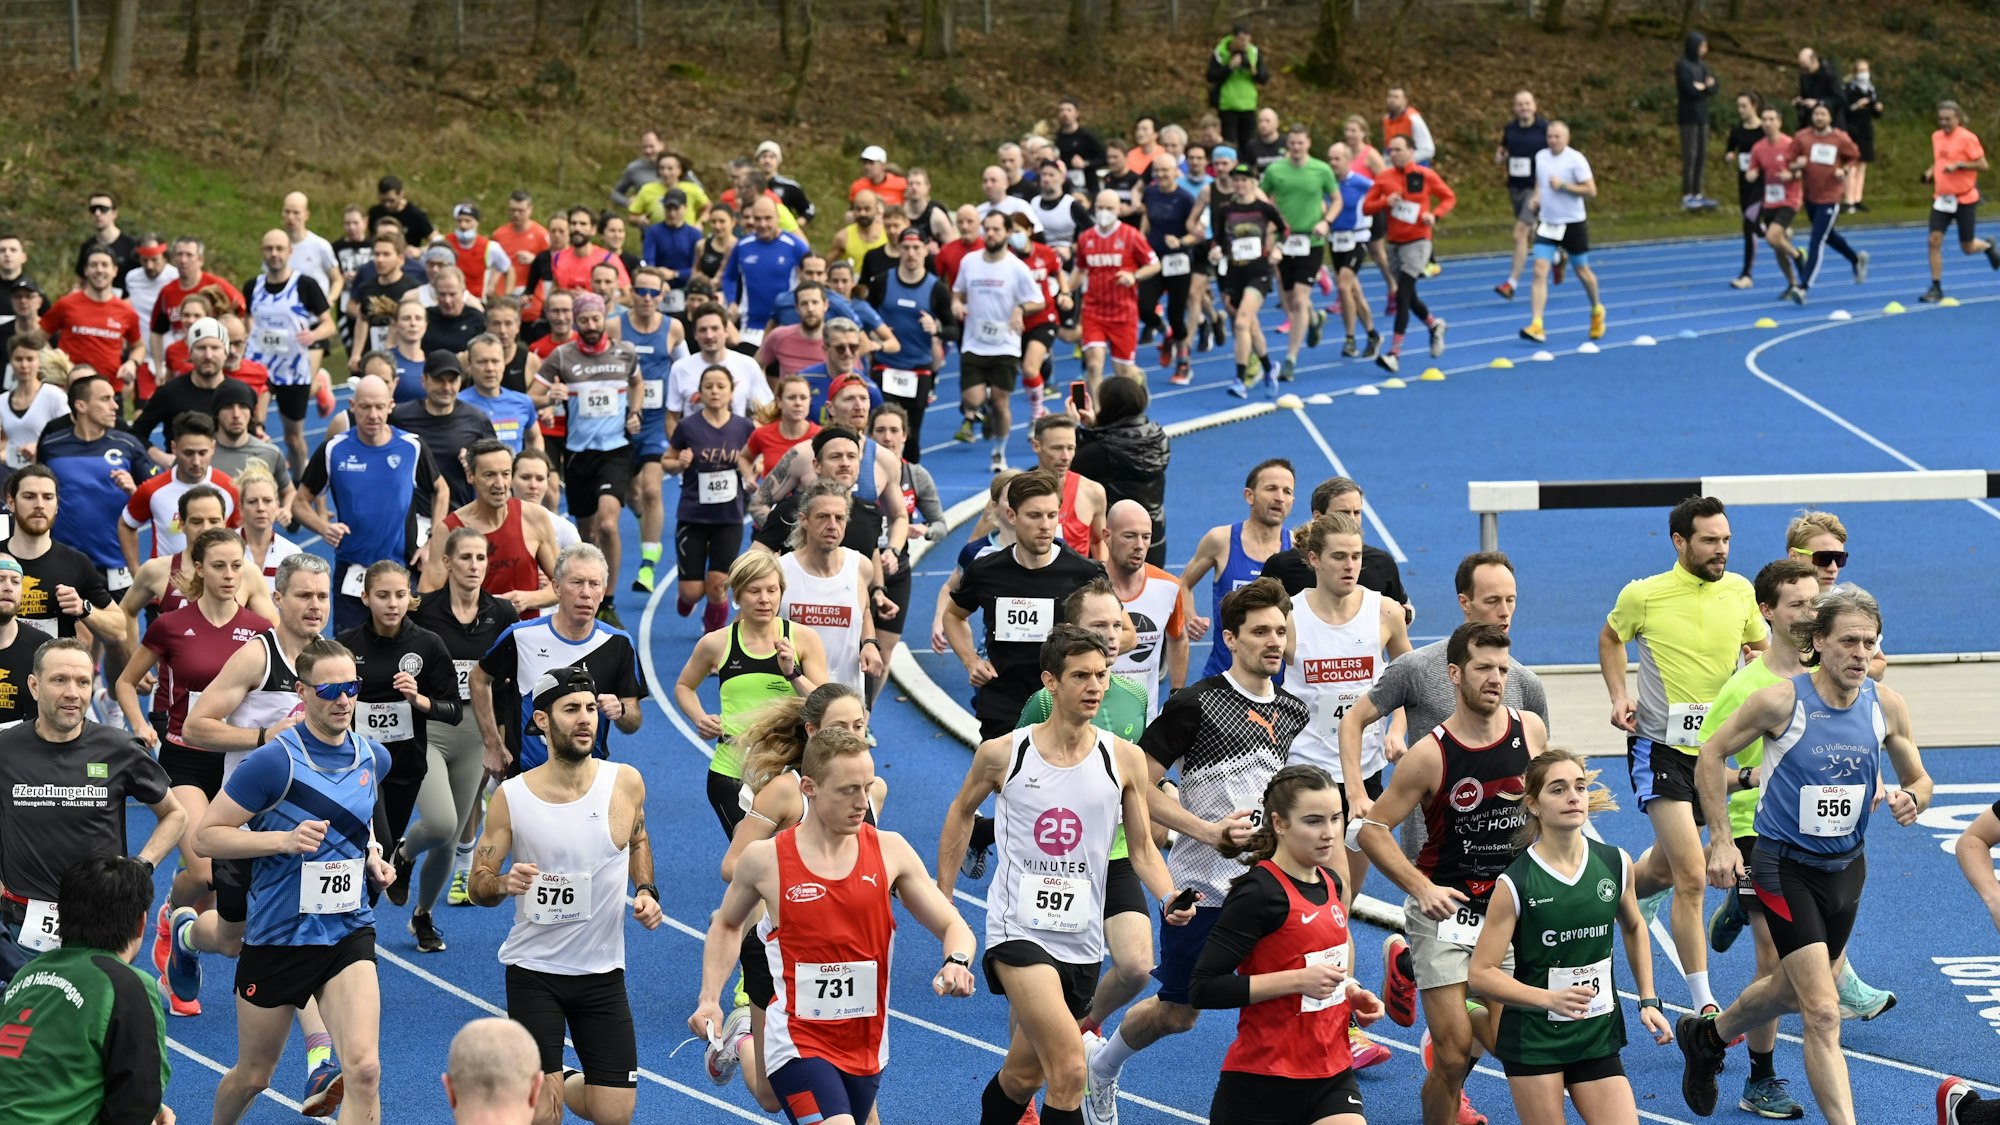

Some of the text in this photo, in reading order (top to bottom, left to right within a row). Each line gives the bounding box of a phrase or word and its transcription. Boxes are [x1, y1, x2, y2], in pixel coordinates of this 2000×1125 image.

[584, 363, 625, 374] central
[588, 396, 609, 407] 528
[708, 480, 728, 491] 482
[805, 606, 841, 615] MILERS
[805, 616, 849, 626] COLONIA
[1007, 610, 1039, 625] 504
[233, 628, 257, 637] ASV
[1321, 659, 1362, 670] MILERS
[1321, 668, 1371, 681] COLONIA
[367, 713, 399, 728] 623
[1812, 745, 1824, 755] LG
[1825, 743, 1870, 755] Vulkaneifel
[13, 785, 108, 799] #ZeroHungerRun
[1455, 790, 1477, 800] ASV
[1822, 786, 1838, 794] GAG
[13, 800, 56, 808] Welthungerhilfe
[1817, 799, 1851, 817] 556
[1492, 806, 1521, 817] PARTN
[1487, 814, 1527, 831] HORN
[1039, 817, 1077, 845] 25
[1023, 859, 1086, 874] MINUTES
[319, 873, 351, 894] 788
[542, 874, 559, 882] GAG
[1043, 877, 1062, 886] GAG
[537, 886, 574, 905] 576
[1036, 890, 1075, 912] 597
[1456, 907, 1480, 927] 65
[1560, 924, 1609, 943] CRYOPOINT
[820, 964, 840, 973] GAG
[22, 974, 34, 989] 09
[32, 971, 85, 1009] Hückeswagen
[815, 977, 854, 999] 731
